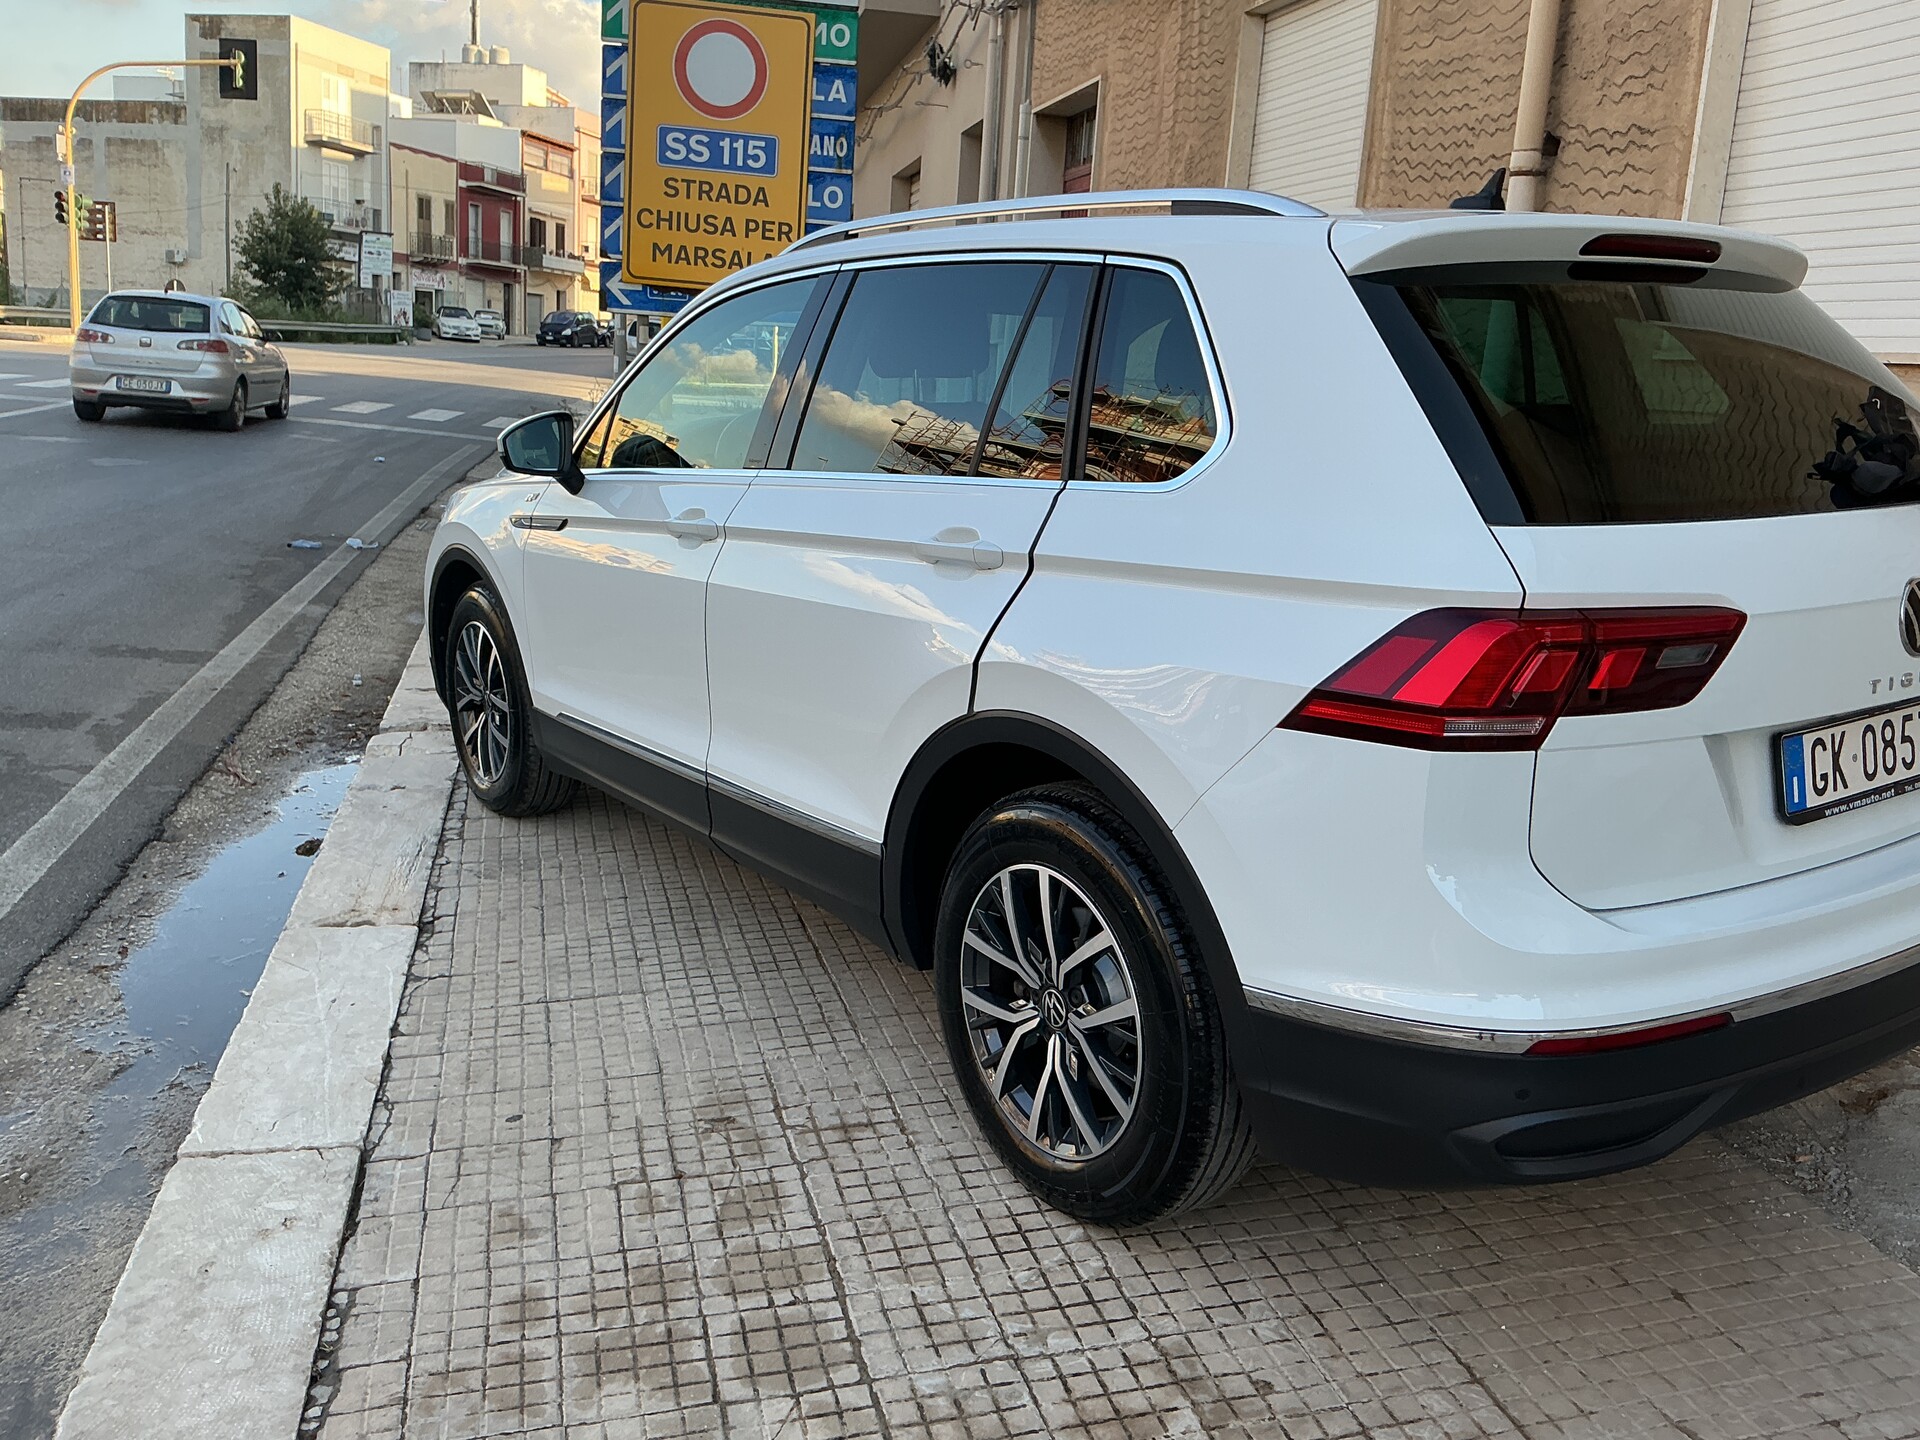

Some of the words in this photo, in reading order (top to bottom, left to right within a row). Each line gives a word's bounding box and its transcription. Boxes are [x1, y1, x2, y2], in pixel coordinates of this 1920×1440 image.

[665, 132, 711, 163] SS
[719, 137, 767, 169] 115
[810, 135, 848, 157] ANO
[663, 177, 770, 208] STRADA
[636, 208, 737, 237] CHIUSA
[744, 218, 793, 242] PER
[1869, 672, 1920, 695] TIG
[1810, 730, 1849, 797] GK
[1861, 711, 1920, 782] 085
[1824, 788, 1895, 816] www.vmauto.net
